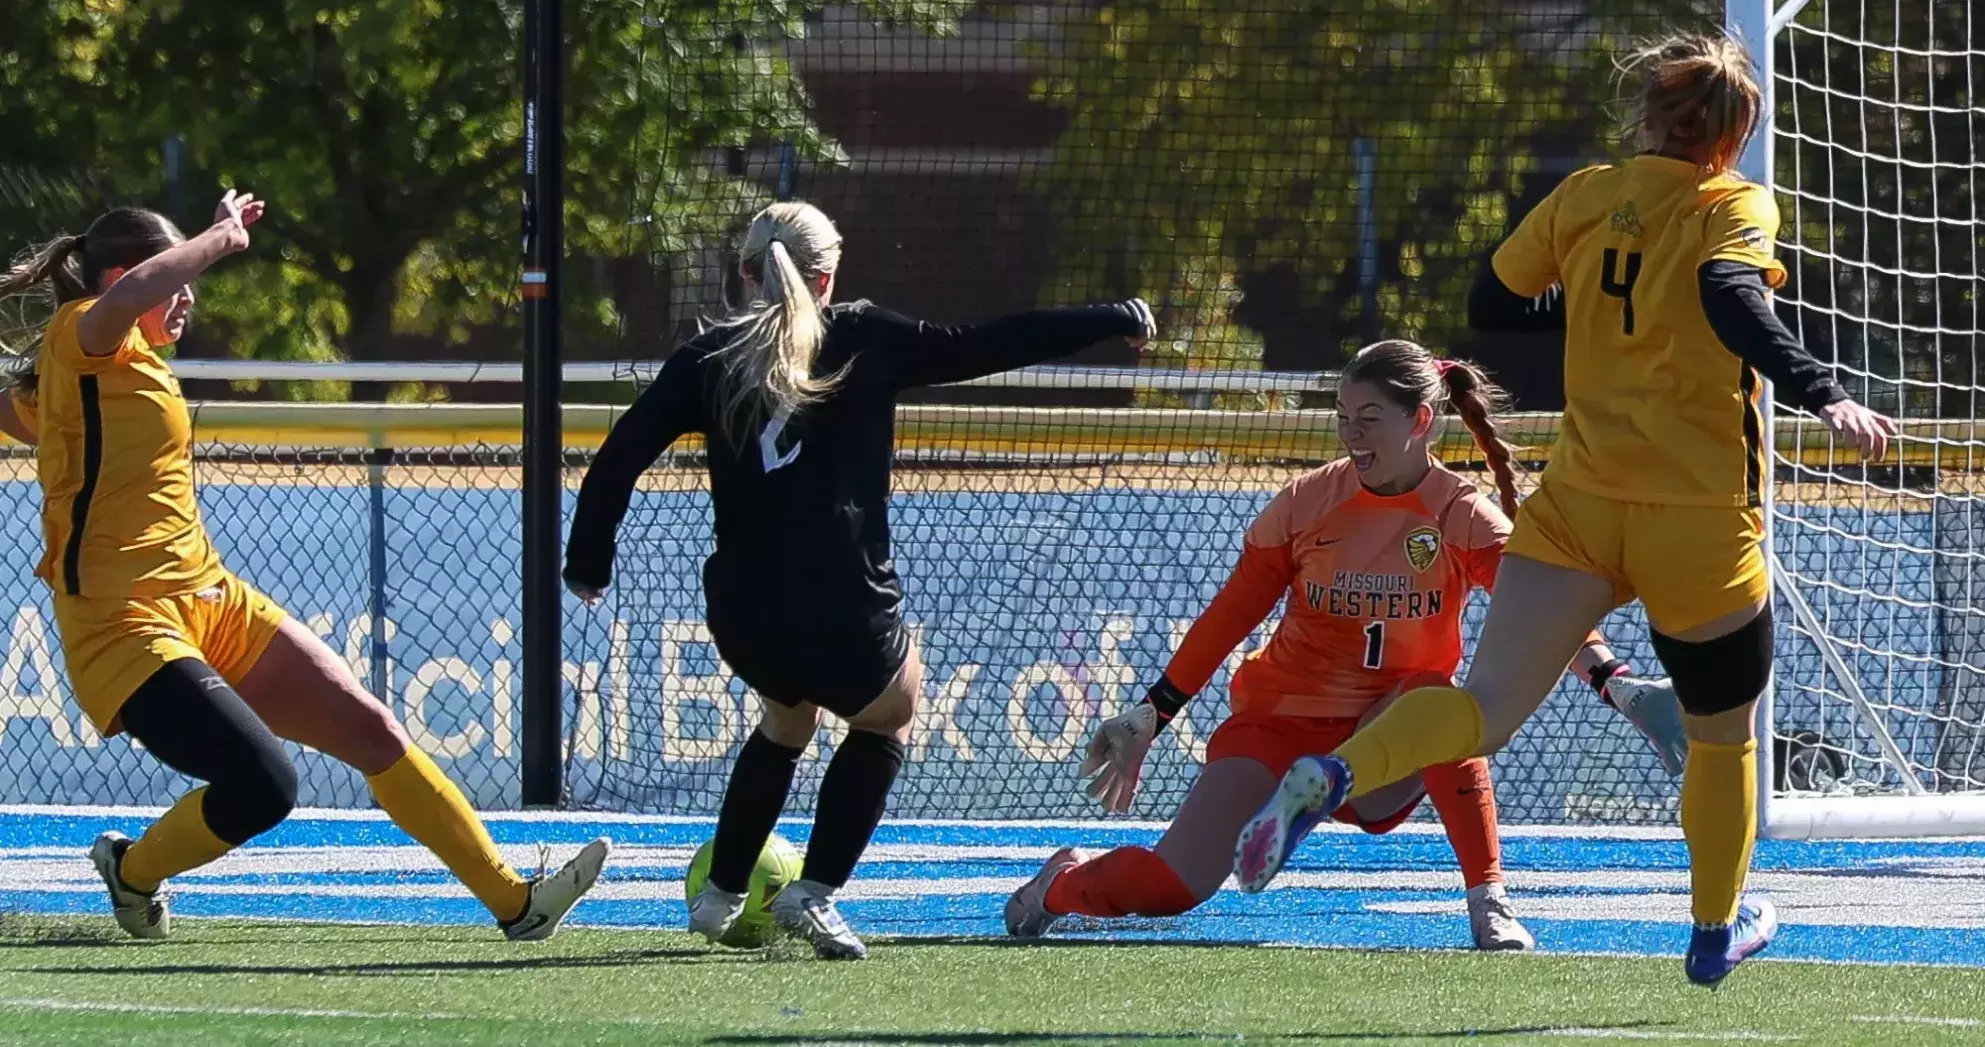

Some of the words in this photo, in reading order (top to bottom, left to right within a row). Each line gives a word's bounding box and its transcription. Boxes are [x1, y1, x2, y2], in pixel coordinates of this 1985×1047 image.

[1600, 247, 1643, 337] 4
[1305, 581, 1443, 620] WESTERN
[1334, 570, 1414, 592] MISSOURI
[1363, 620, 1385, 670] 1
[660, 617, 980, 763] Bk
